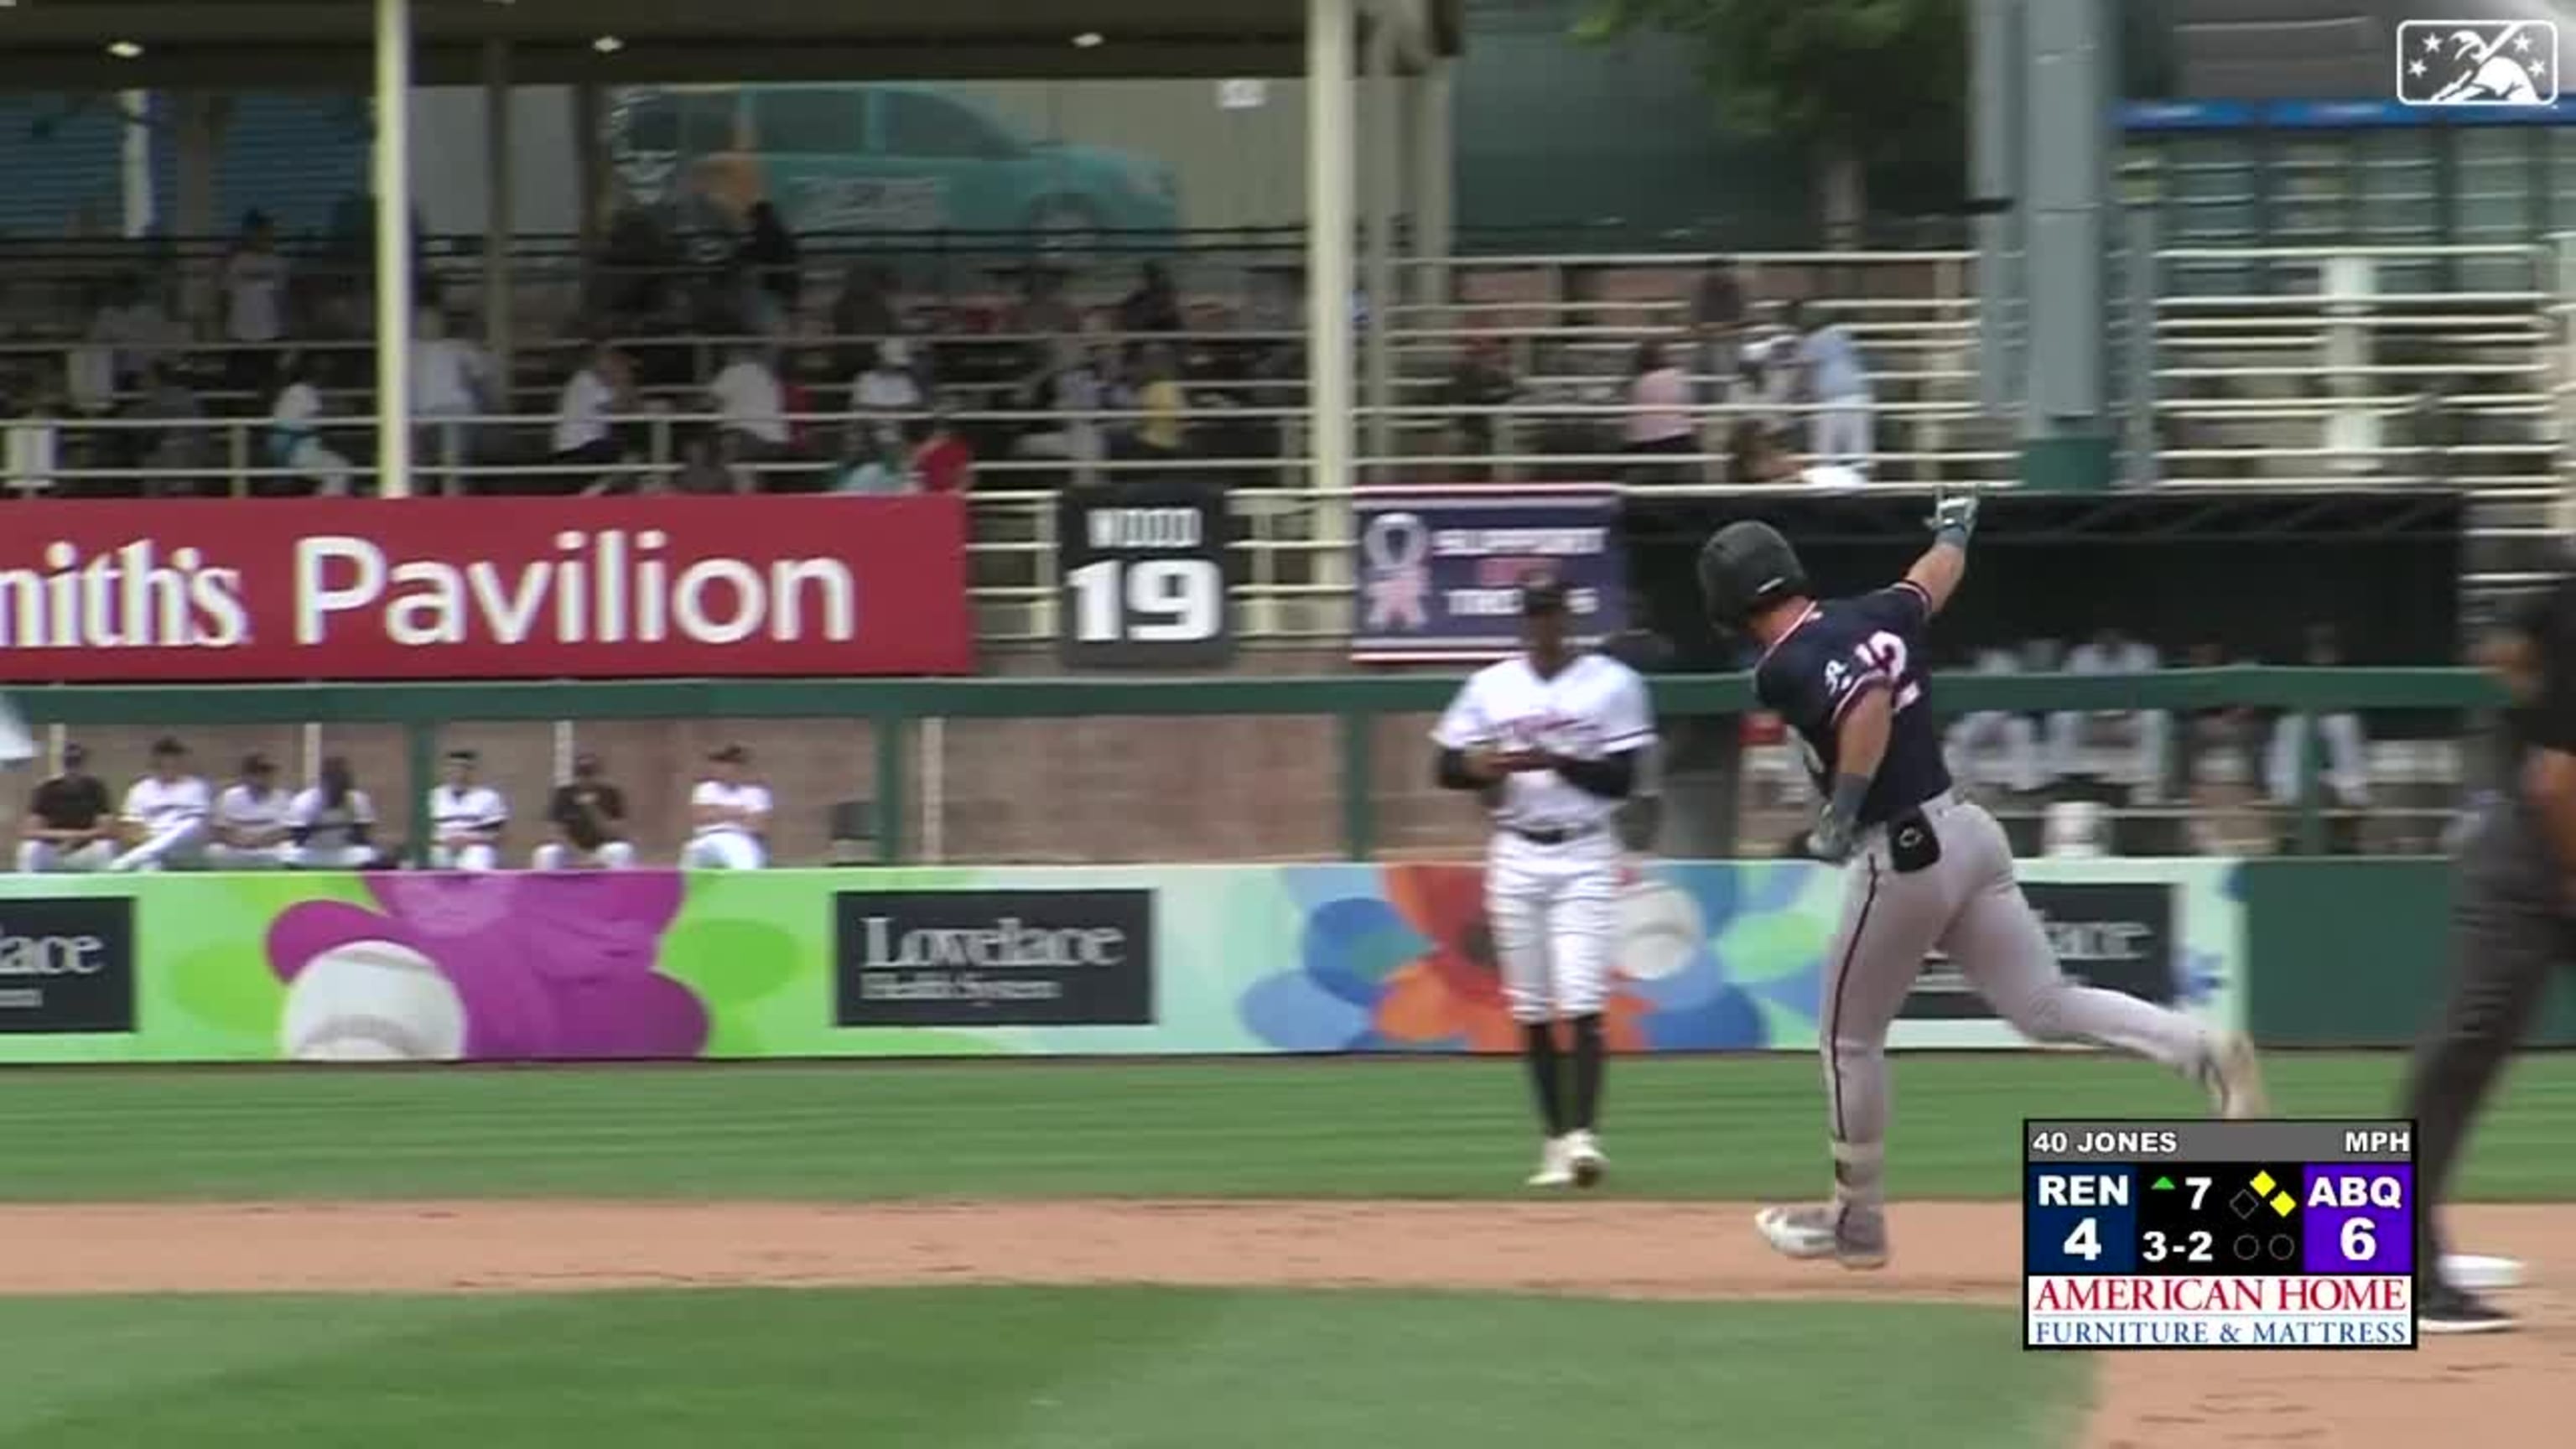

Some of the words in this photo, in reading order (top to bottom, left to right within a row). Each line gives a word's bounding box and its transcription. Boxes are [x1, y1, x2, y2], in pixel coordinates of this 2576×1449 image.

[295, 529, 854, 644] Pavilion
[1065, 558, 1221, 641] 19
[861, 917, 1125, 967] Lovelace
